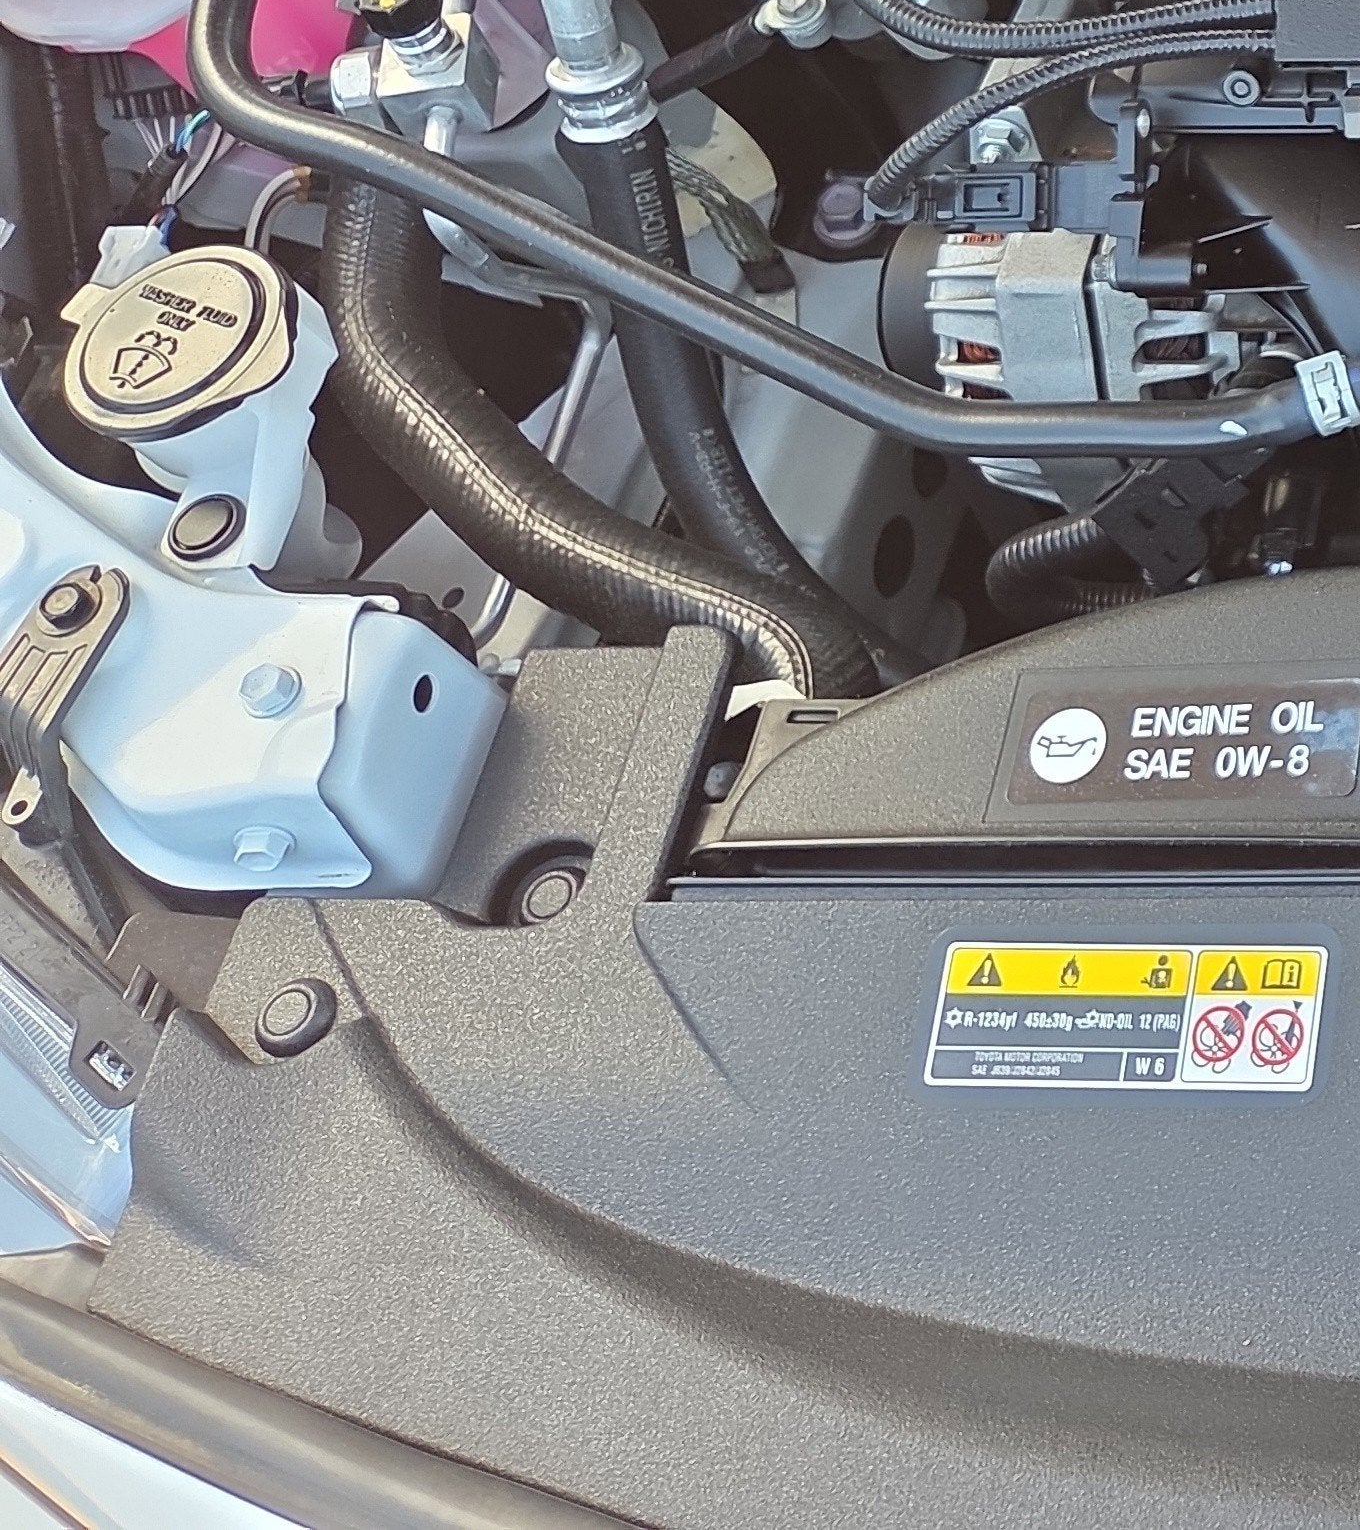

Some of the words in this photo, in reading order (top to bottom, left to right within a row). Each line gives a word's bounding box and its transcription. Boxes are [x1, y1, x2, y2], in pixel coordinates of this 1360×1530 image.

[629, 168, 671, 253] NICHIRIN
[139, 283, 196, 314] WASHER
[196, 305, 238, 328] FLUID
[156, 311, 196, 332] ONLY
[1131, 703, 1252, 738] ENGINE
[1270, 700, 1324, 734] OIL
[1123, 747, 1194, 780] SAE
[1215, 743, 1310, 778] 0W-8
[1099, 1012, 1134, 1030] ND-OIL
[1139, 1013, 1152, 1030] 12
[1152, 1013, 1180, 1032] (PAG)
[974, 1051, 1003, 1062] TOYOTA
[1004, 1052, 1031, 1063] MOTOR
[1031, 1052, 1084, 1063] CORPORATION
[1135, 1057, 1152, 1076] W
[1154, 1057, 1165, 1076] 6
[971, 1064, 988, 1076] SAE
